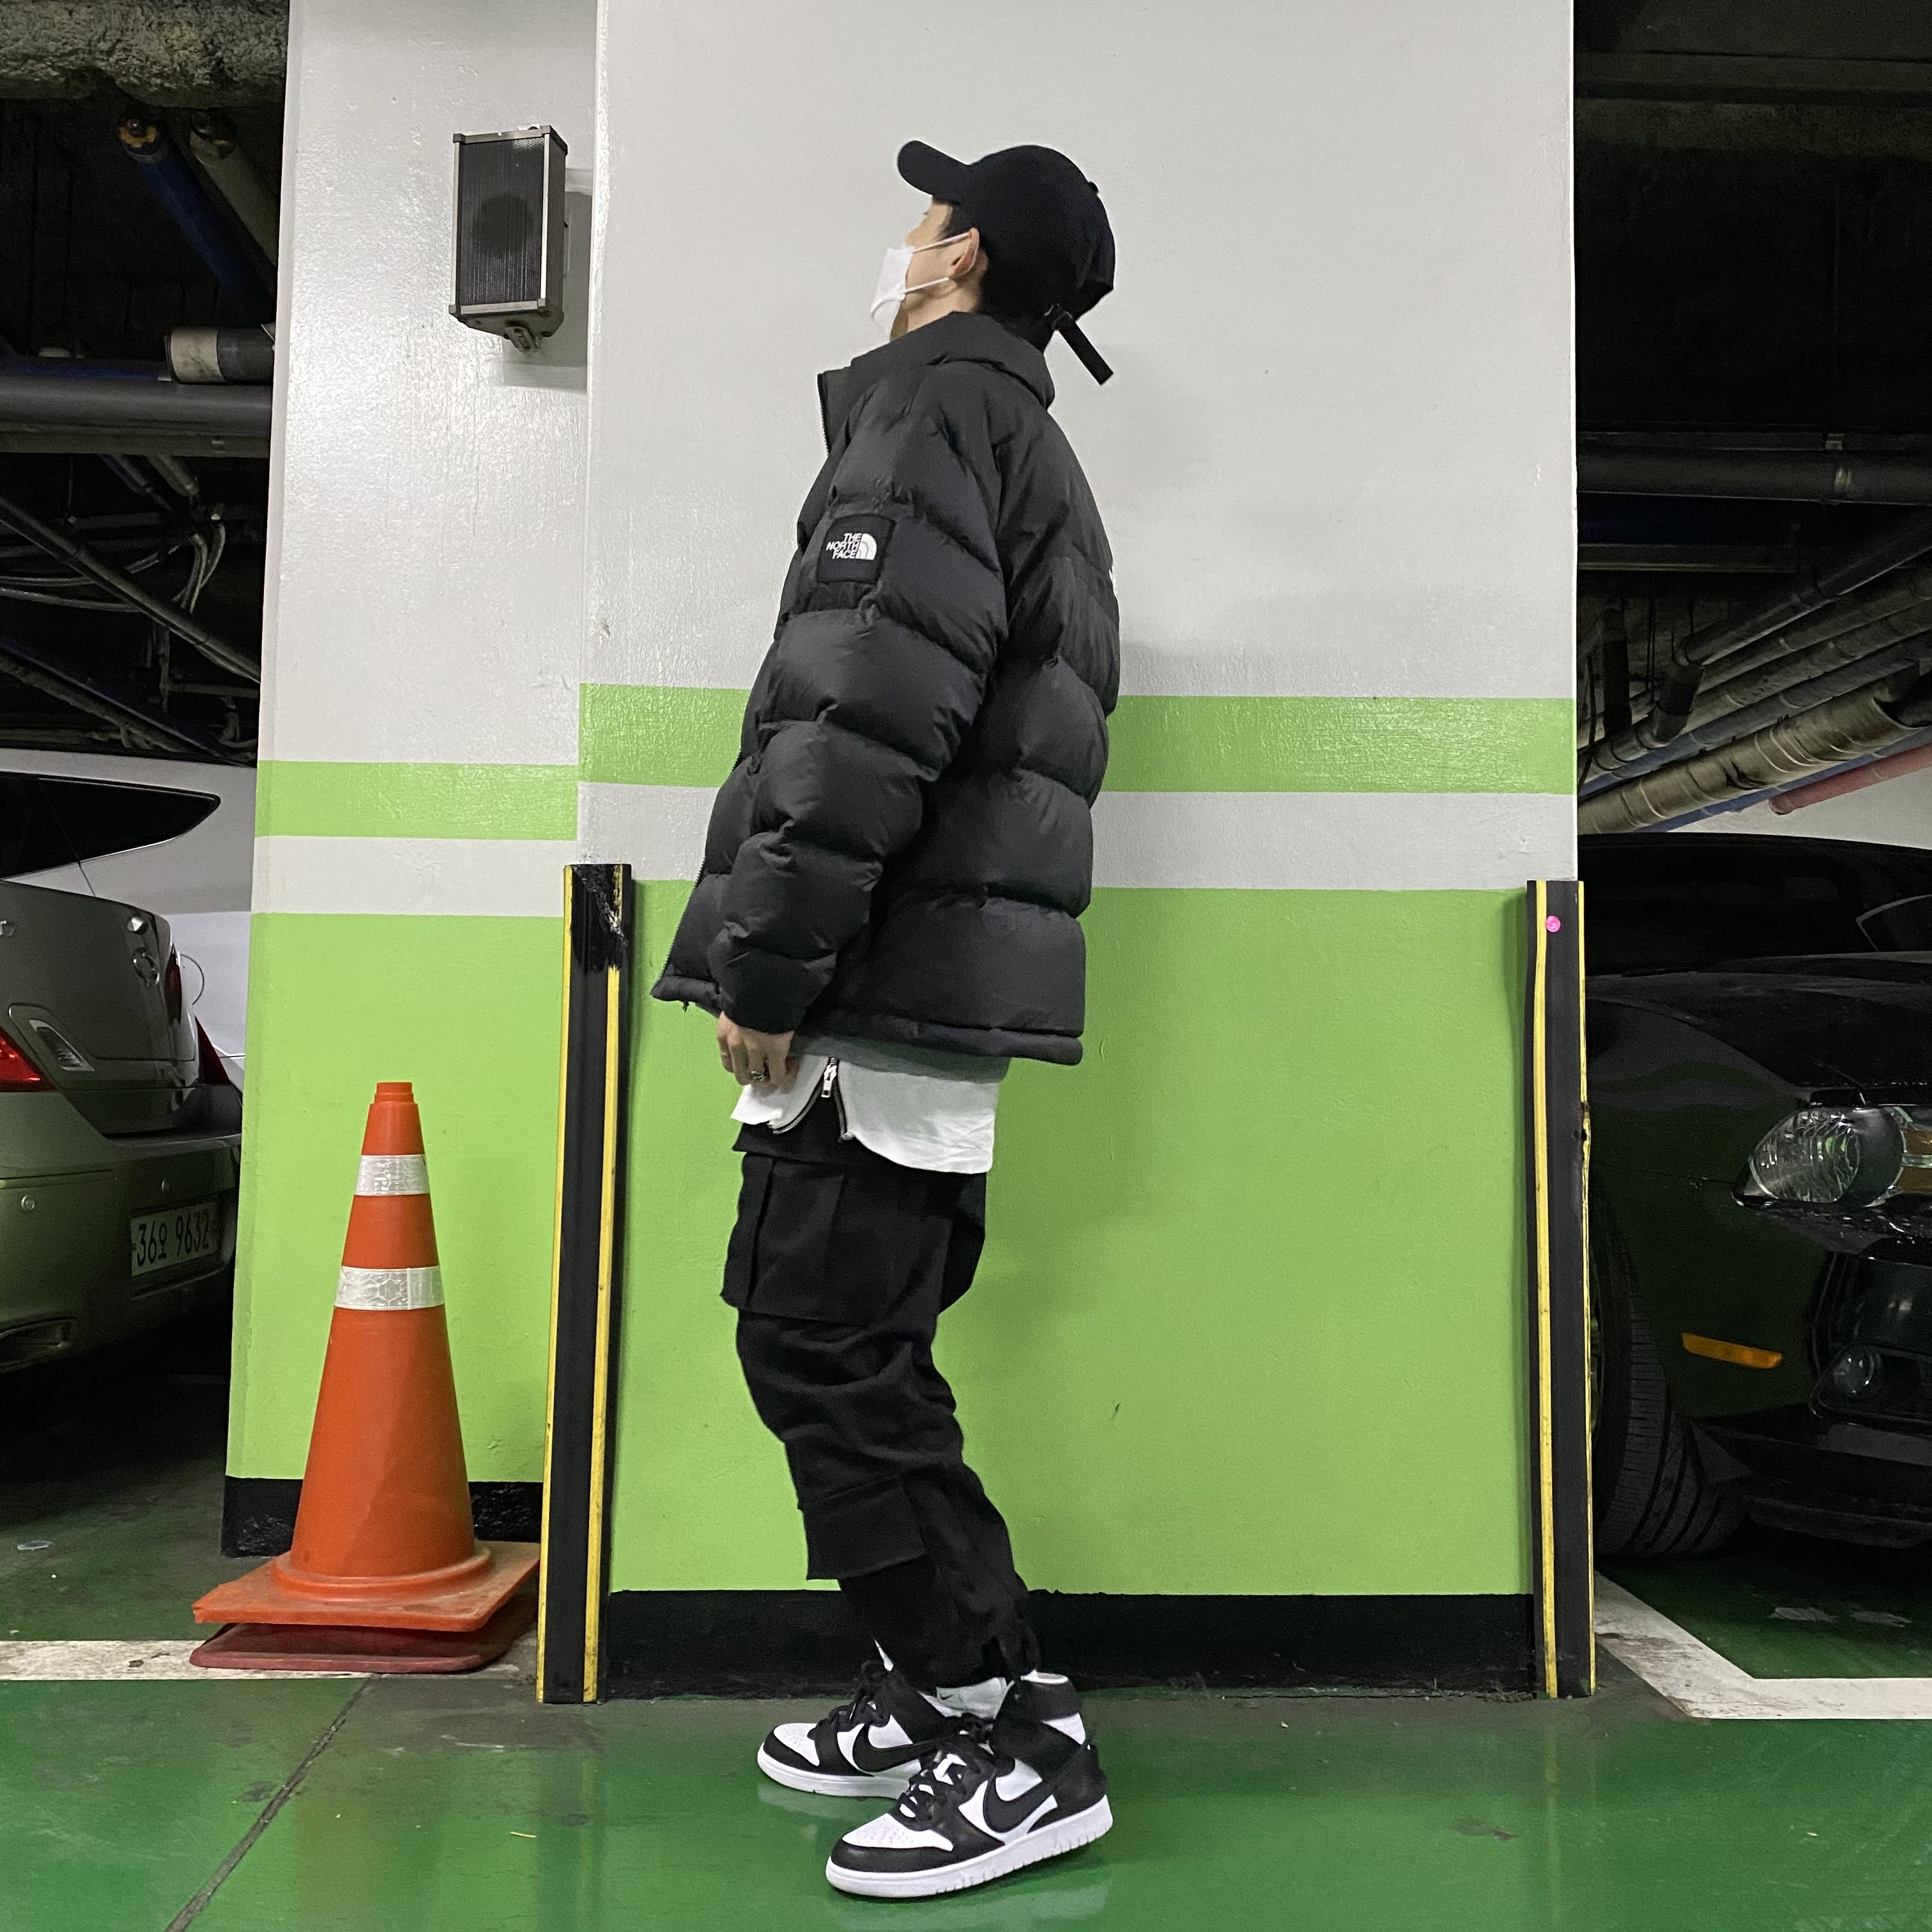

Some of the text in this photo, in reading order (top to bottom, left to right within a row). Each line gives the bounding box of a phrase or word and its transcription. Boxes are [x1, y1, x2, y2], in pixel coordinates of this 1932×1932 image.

[844, 533, 862, 542] THE
[826, 541, 860, 551] NORTH
[832, 550, 857, 560] FACE
[137, 1209, 210, 1266] 36오 9632
